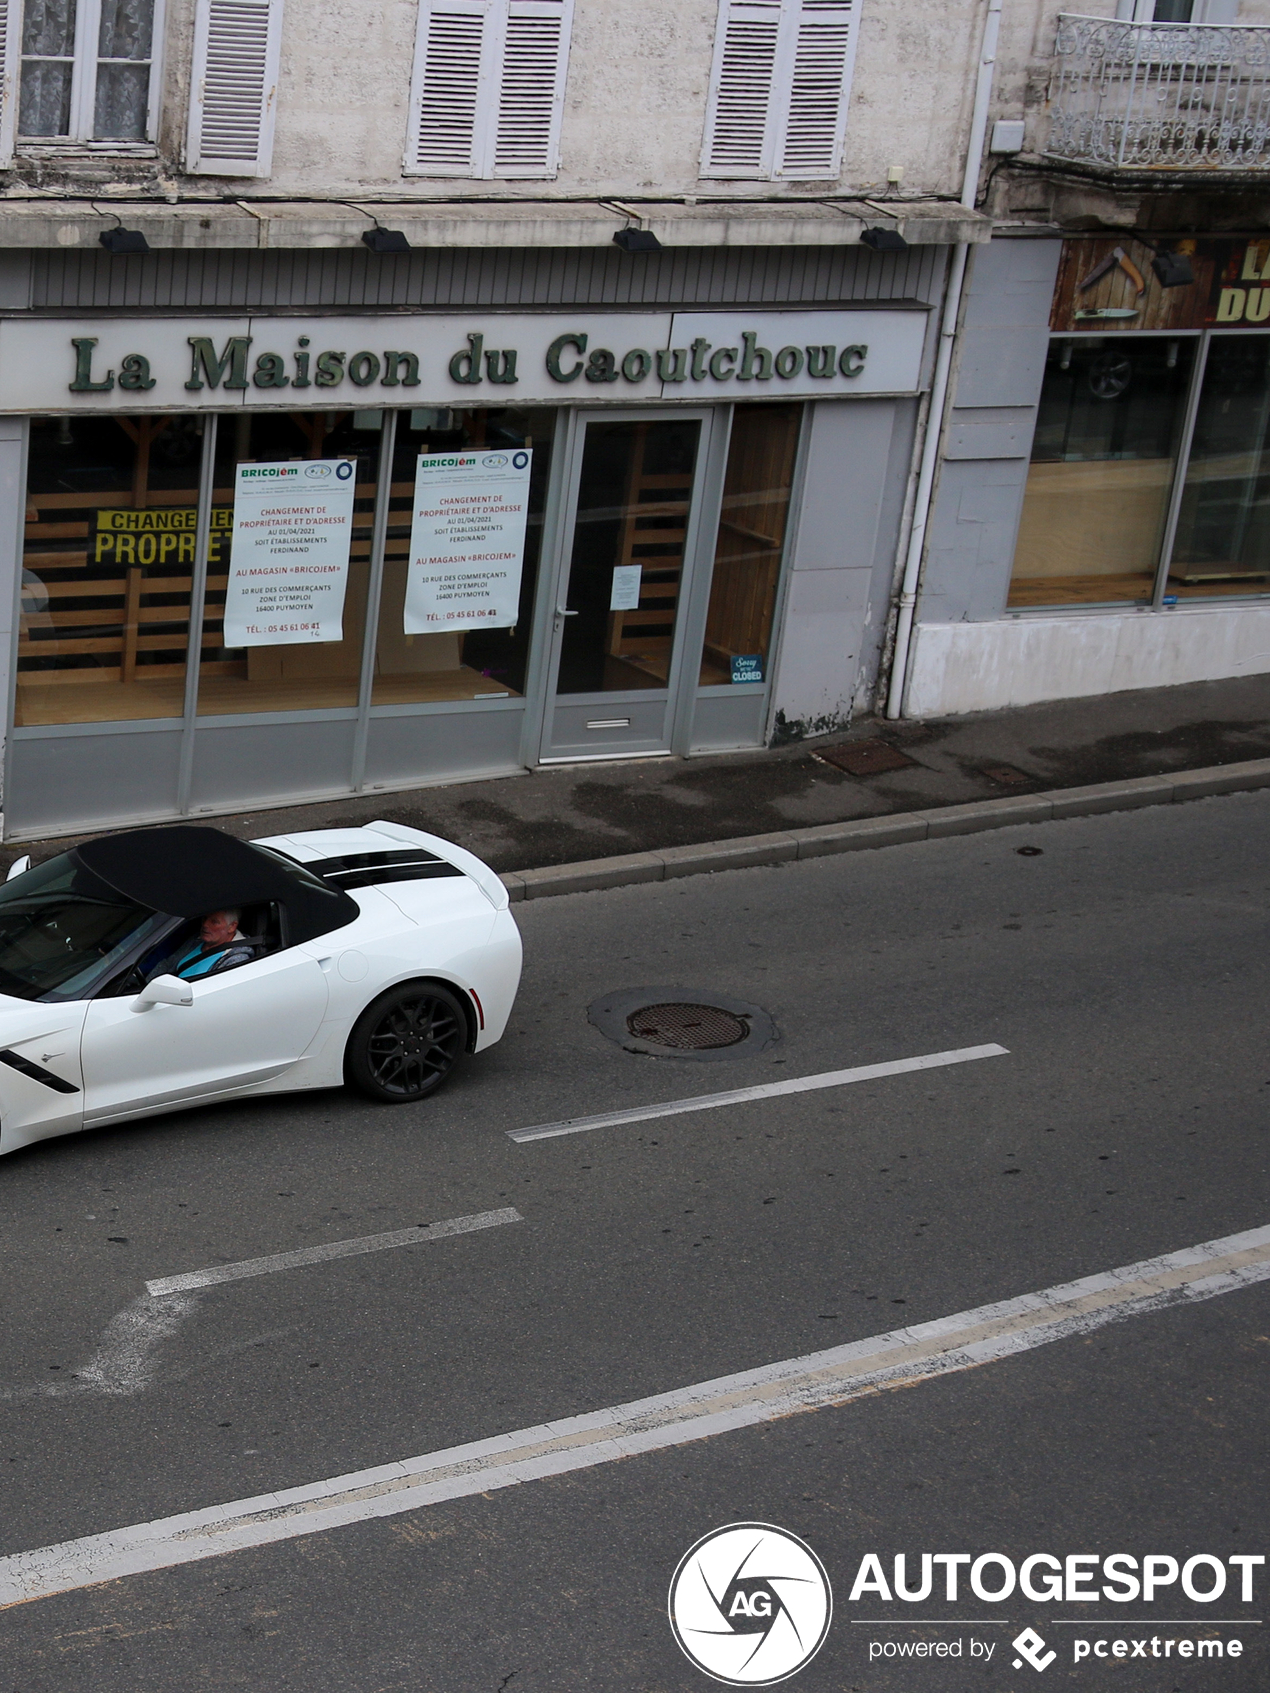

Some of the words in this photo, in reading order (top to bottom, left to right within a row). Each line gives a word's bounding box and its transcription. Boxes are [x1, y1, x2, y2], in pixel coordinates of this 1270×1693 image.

[1241, 246, 1270, 280] L
[71, 337, 157, 392] La
[185, 335, 420, 390] Maison
[449, 333, 519, 385] du
[546, 331, 869, 383] Caoutchouc
[440, 496, 491, 505] CHANGEMENT
[260, 507, 314, 516] CHANGEMENT
[317, 506, 326, 514] DE
[419, 508, 470, 517] PROPRIÉTAIRE
[483, 505, 522, 513] D'ADRESSE
[111, 512, 234, 528] CHANGEE
[239, 517, 292, 528] PROPRIÉTAIRE
[306, 516, 346, 525] D'ADRESSE
[450, 525, 503, 534] ÉTABLISSEMENTS
[270, 537, 327, 545] ÉTABLISSEMENTS
[450, 535, 486, 543] FERDINAND
[95, 532, 233, 564] PROPRE
[429, 556, 466, 564] MAGASIN
[236, 569, 247, 577] AU
[250, 567, 288, 576] MAGASIN
[458, 572, 506, 580] COMMERÇANTS
[733, 672, 762, 681] CLOSED
